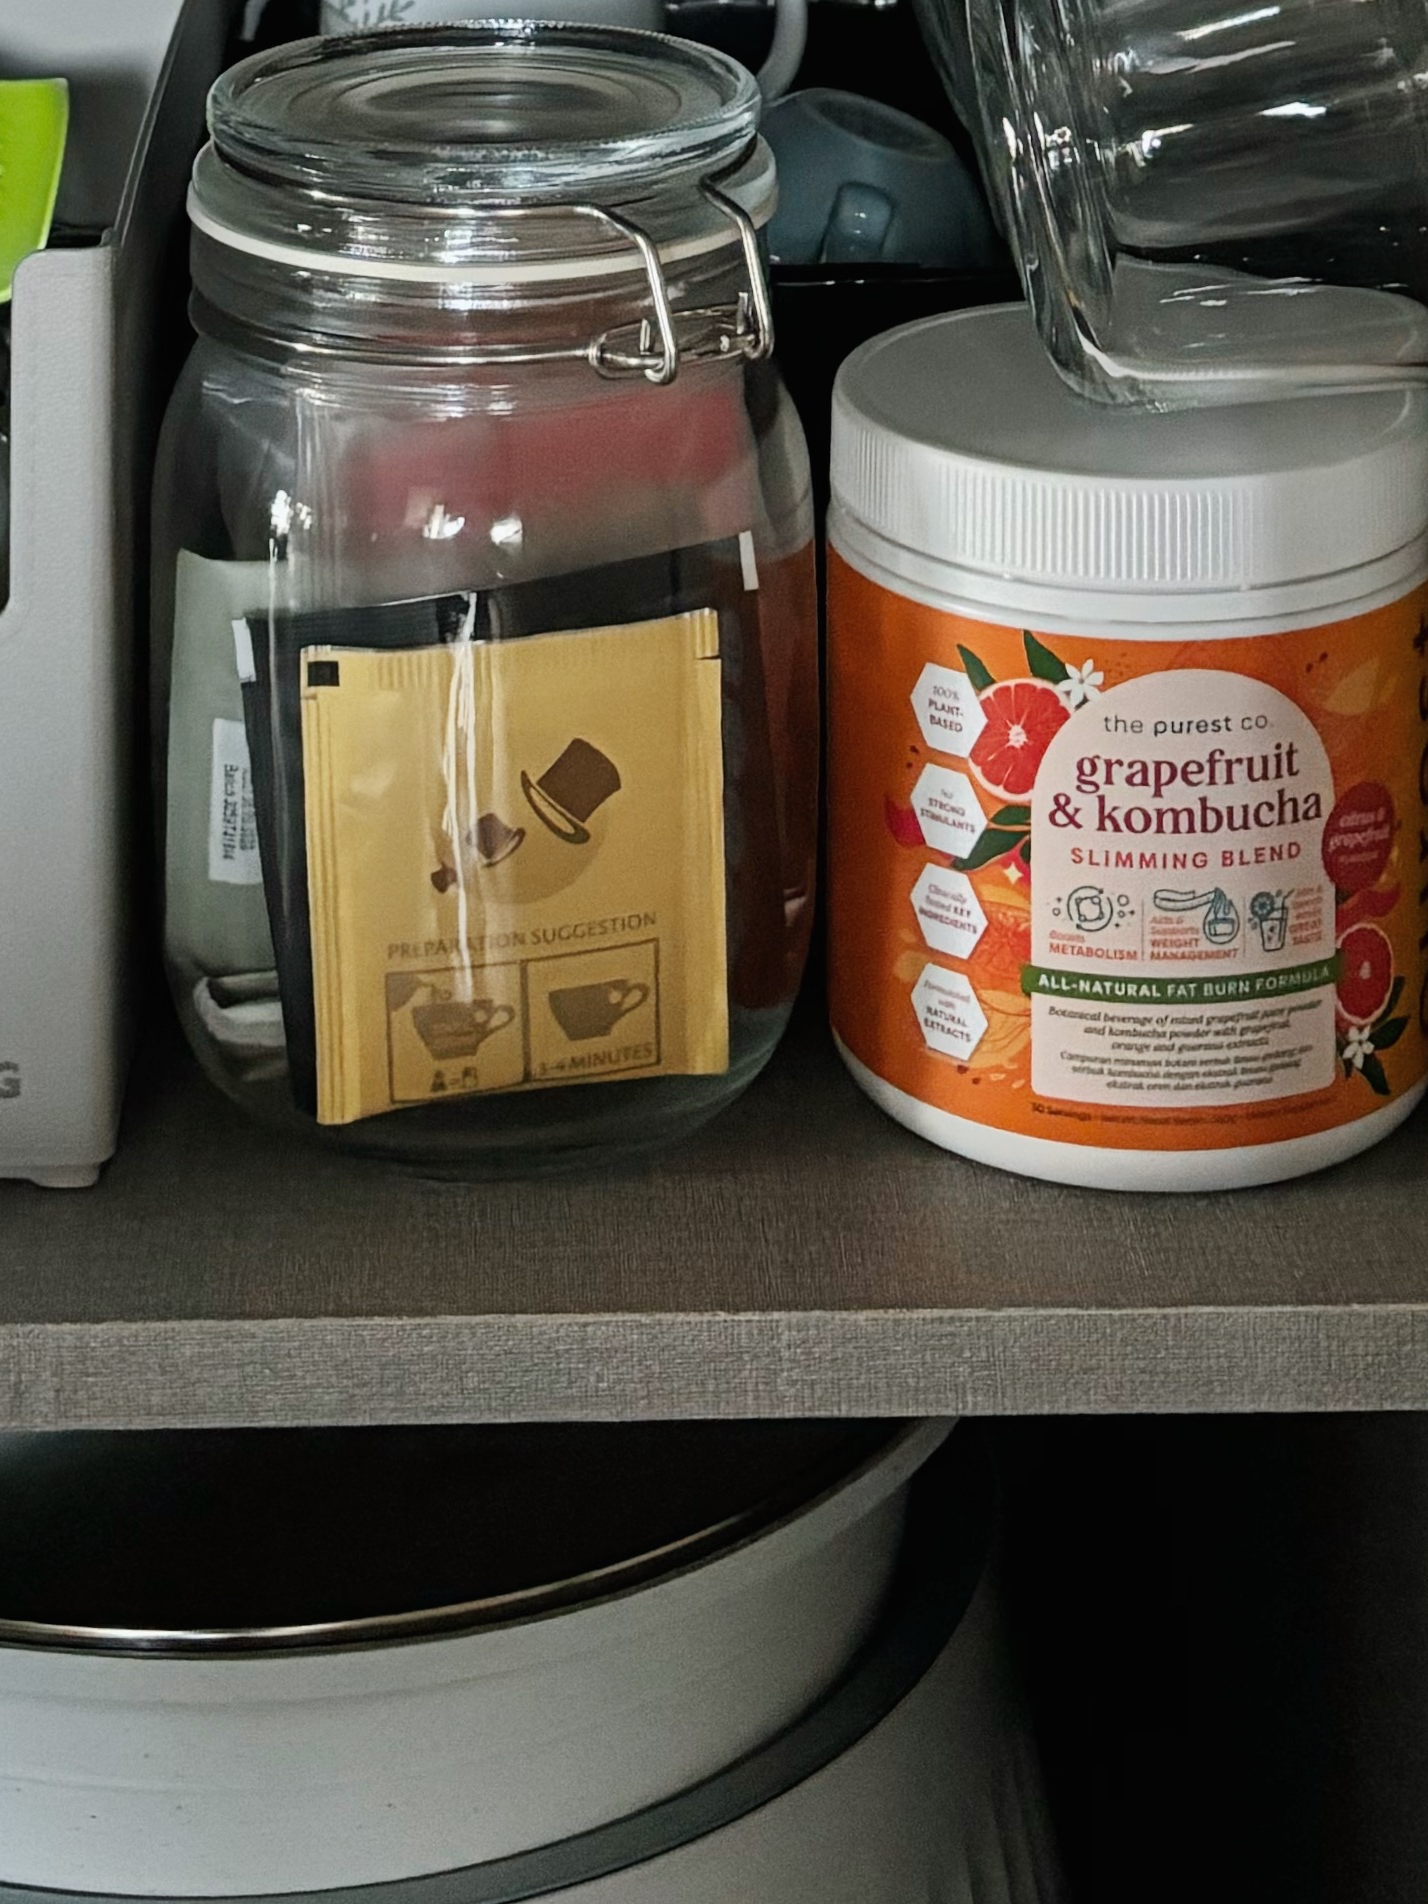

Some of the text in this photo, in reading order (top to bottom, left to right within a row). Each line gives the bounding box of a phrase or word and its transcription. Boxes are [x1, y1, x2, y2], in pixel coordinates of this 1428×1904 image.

[928, 714, 963, 734] BASED
[1103, 714, 1144, 735] the
[1153, 715, 1233, 738] purest
[1075, 741, 1300, 799] grapefruit
[1047, 787, 1323, 835] & kombucha
[1070, 841, 1302, 870] SLIMMING BLEND
[530, 911, 658, 947] SUGGESTION
[1048, 943, 1138, 961] METABOLISM
[1149, 938, 1201, 948] WEIGHT
[1149, 948, 1240, 961] MANAGEMENT
[1038, 966, 1330, 998] ALL-NATURAL FAT BURN FORMULA
[568, 1043, 654, 1070] MINUTES
